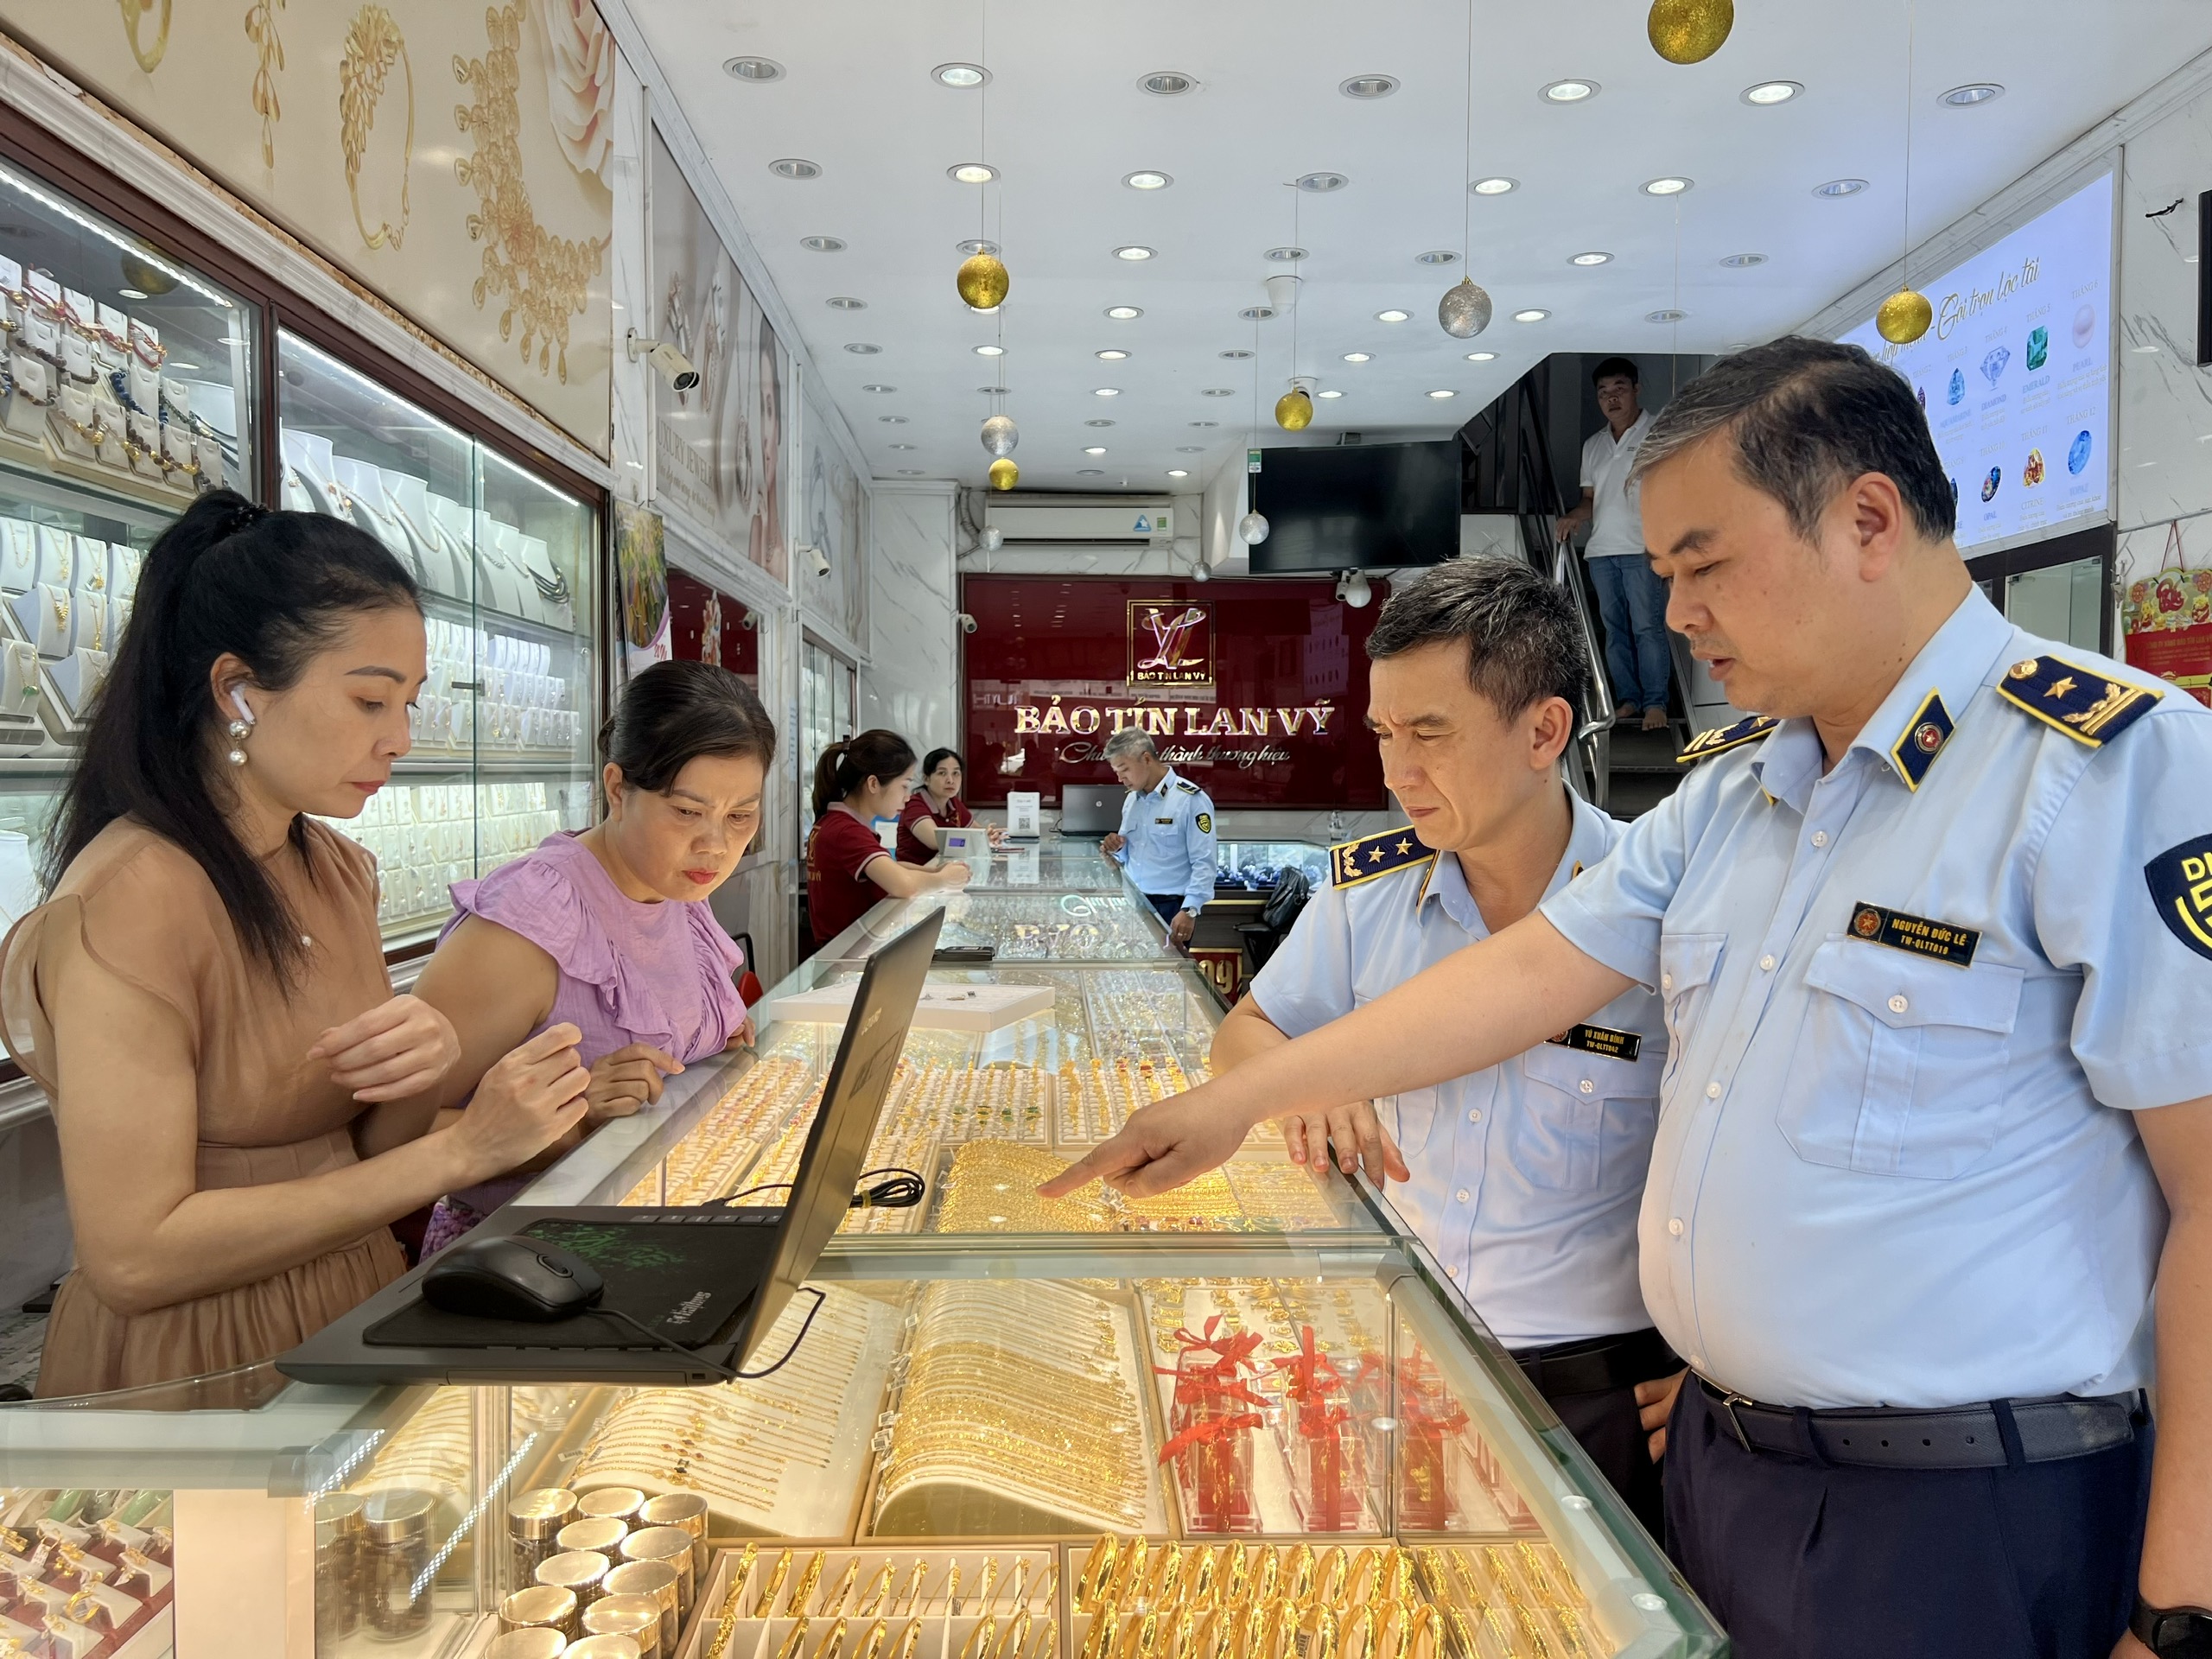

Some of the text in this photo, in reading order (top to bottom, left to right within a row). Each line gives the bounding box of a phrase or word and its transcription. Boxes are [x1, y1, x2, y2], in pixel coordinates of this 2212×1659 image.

[657, 416, 686, 465] UXURY
[687, 444, 717, 496] JEWELR
[1014, 695, 1101, 734] BẢO
[1105, 696, 1176, 735] TÍN
[1184, 706, 1272, 735] LAN
[1276, 697, 1336, 735] VỸ
[1891, 918, 1967, 946] NGUYỄN ĐỨC LÊ
